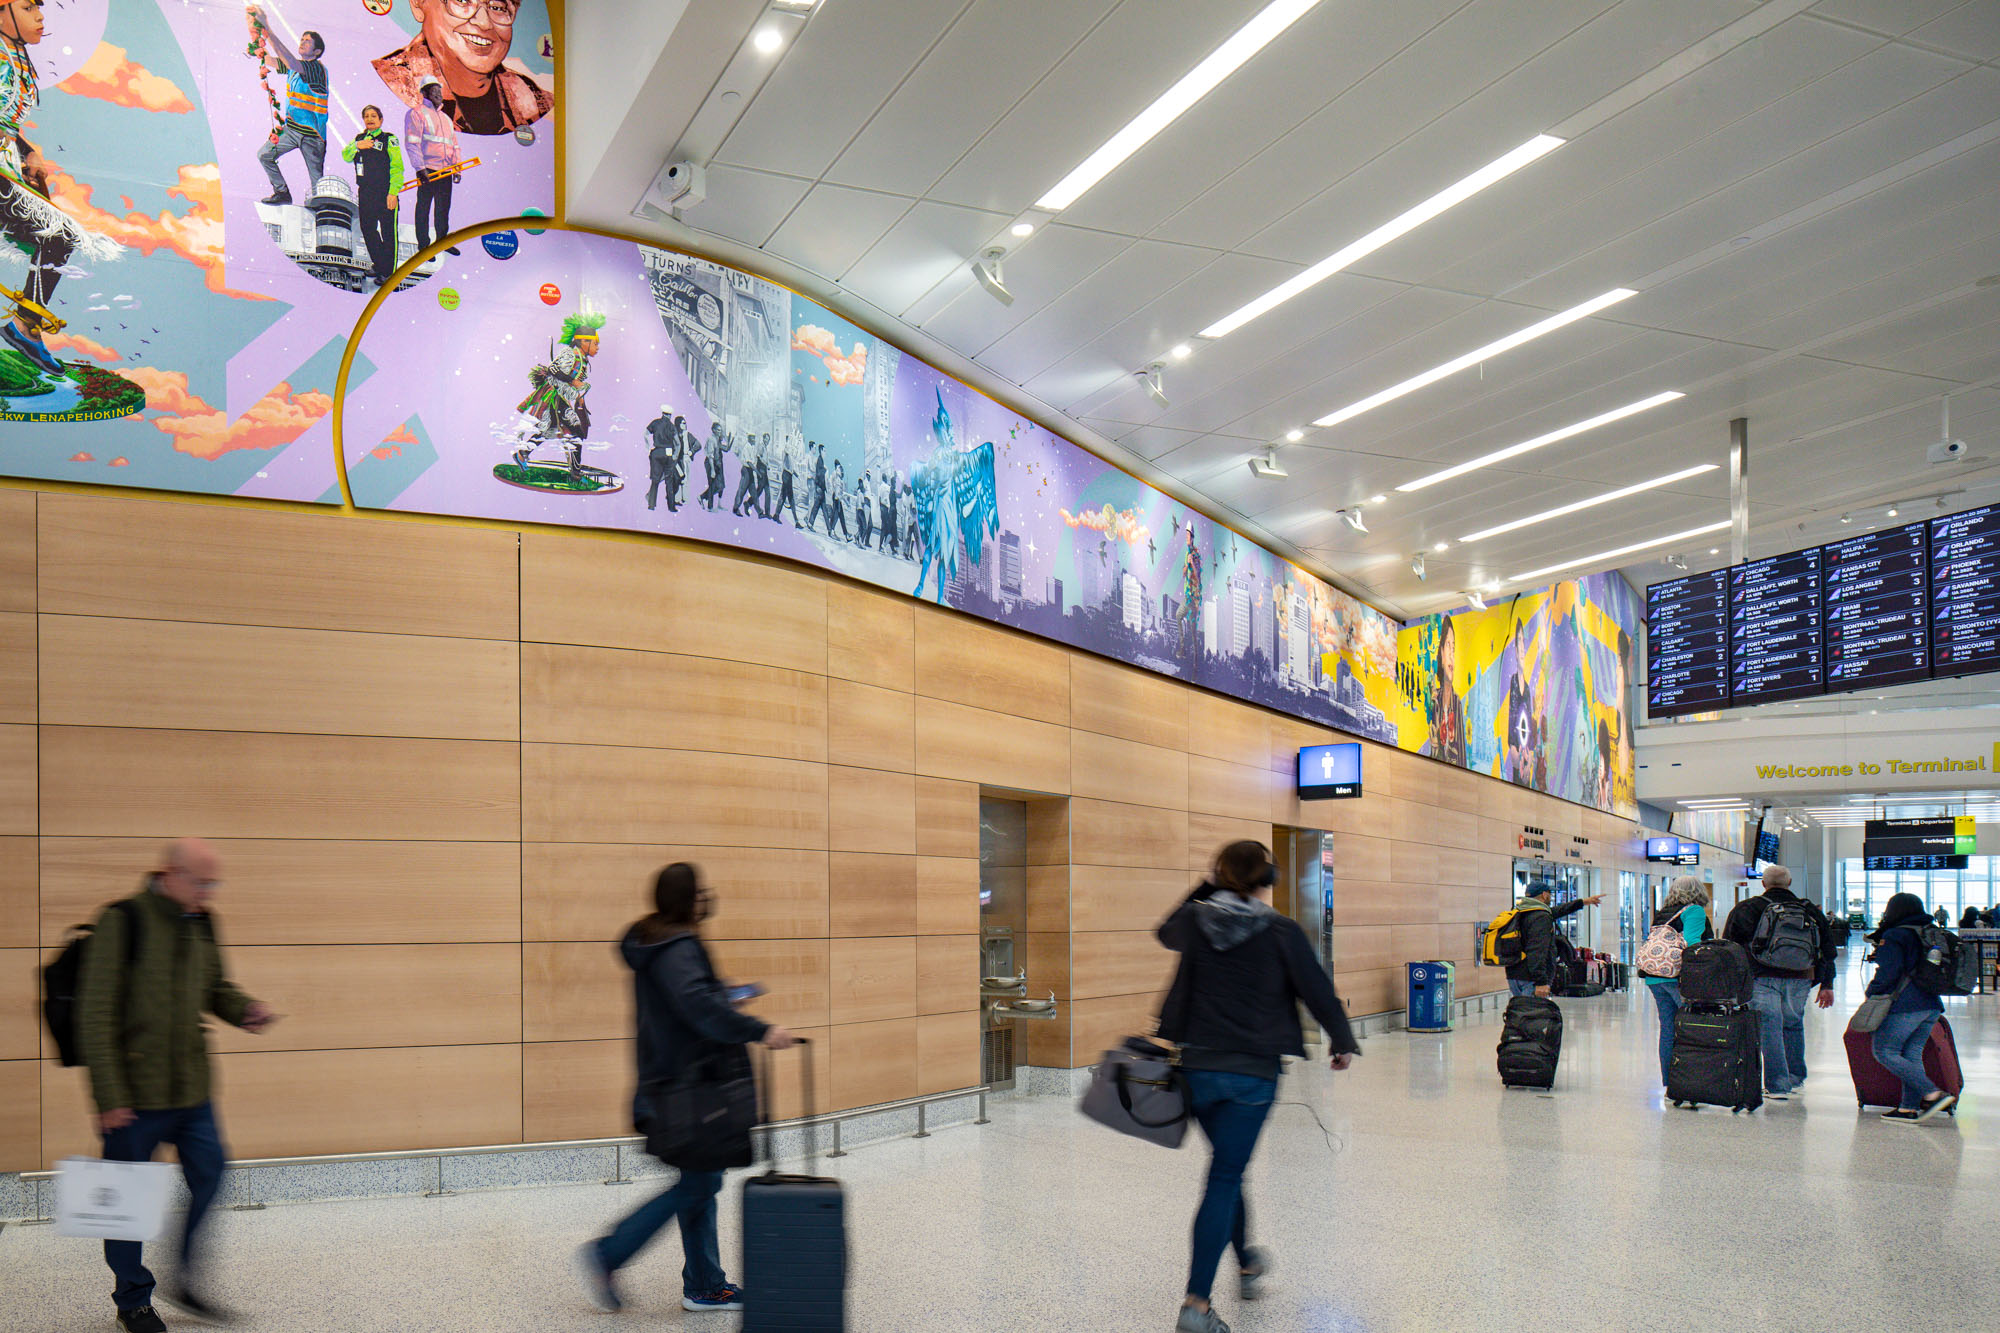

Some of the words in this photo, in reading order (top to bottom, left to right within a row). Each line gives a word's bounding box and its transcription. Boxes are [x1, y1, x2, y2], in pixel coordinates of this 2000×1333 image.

[652, 253, 692, 275] TURNS
[30, 405, 135, 422] LENAPEHOKING
[1951, 517, 1984, 528] ORLANDO
[1951, 538, 1984, 549] ORLANDO
[1841, 544, 1866, 554] HALIFAX
[1841, 563, 1866, 573] KANSAS
[1867, 559, 1881, 567] CITY
[1951, 559, 1981, 569] PHOENIX
[1746, 567, 1770, 575] CHICAGO
[1778, 579, 1798, 587] WORTH
[1855, 579, 1883, 589] ANGELES
[1913, 577, 1920, 585] 3
[1951, 579, 1989, 590] SAVANNAH
[1778, 597, 1798, 605] WORTH
[1952, 602, 1975, 610] TAMPA
[1661, 621, 1681, 629] BOSTON
[1761, 616, 1797, 627] LAUDERDALE
[1953, 622, 1985, 630] TORONTO
[1762, 634, 1797, 645] LAUDERDALE
[1915, 637, 1922, 645] 5
[1953, 641, 1995, 651] VANCOUVER
[1662, 654, 1693, 662] CHARLESTON
[1762, 653, 1797, 663] LAUDERDALE
[1916, 657, 1922, 665] 2
[1844, 660, 1869, 668] NASSAU
[1662, 671, 1690, 679] CHARLOTTE
[1755, 764, 1853, 779] Welcome
[1858, 761, 1881, 776] to
[1886, 755, 1987, 774] Terminal
[1335, 786, 1352, 795] Men
[1920, 818, 1954, 826] Departures
